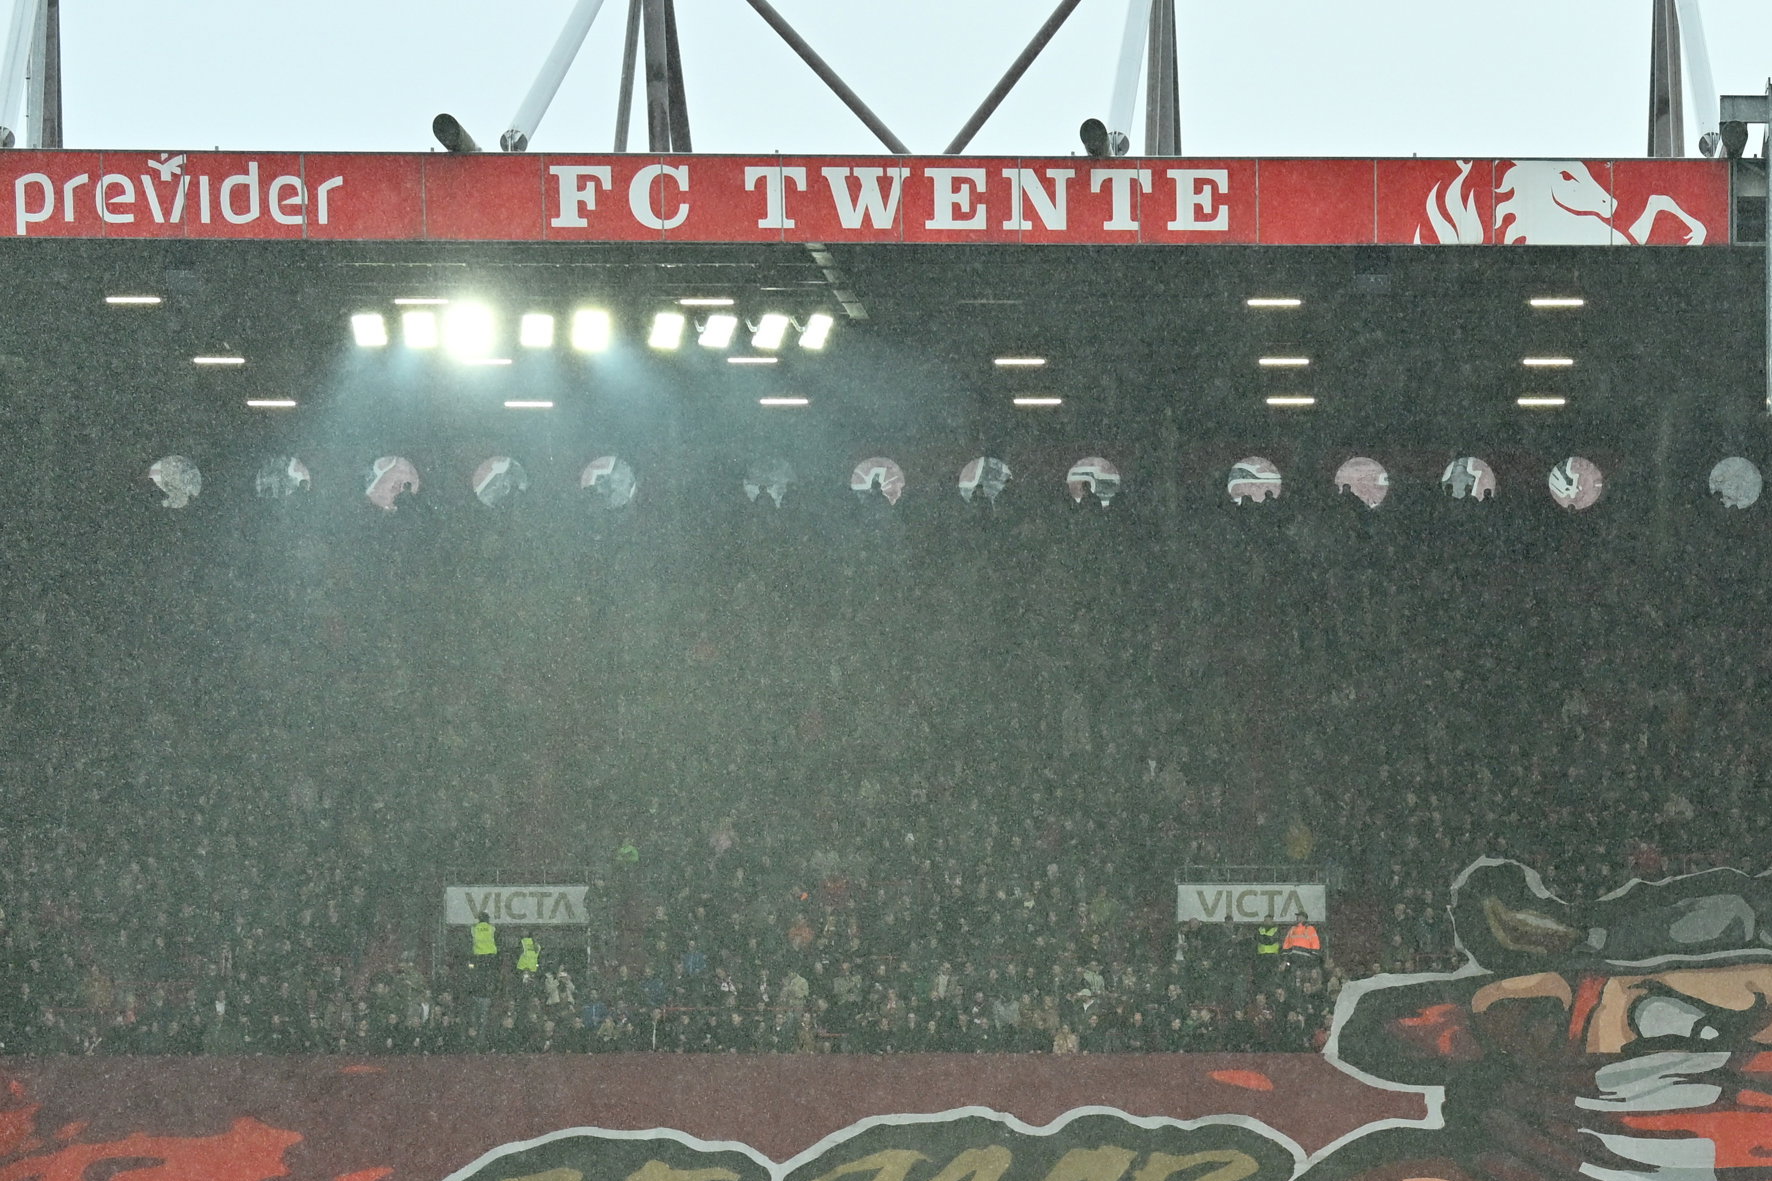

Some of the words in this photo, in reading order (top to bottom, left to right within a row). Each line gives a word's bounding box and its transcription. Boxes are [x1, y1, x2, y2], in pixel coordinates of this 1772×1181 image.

[15, 160, 344, 235] previder
[550, 163, 690, 231] FC
[744, 165, 1229, 232] TWENTE
[465, 891, 576, 920] VICTA
[1196, 889, 1305, 919] VICTA
